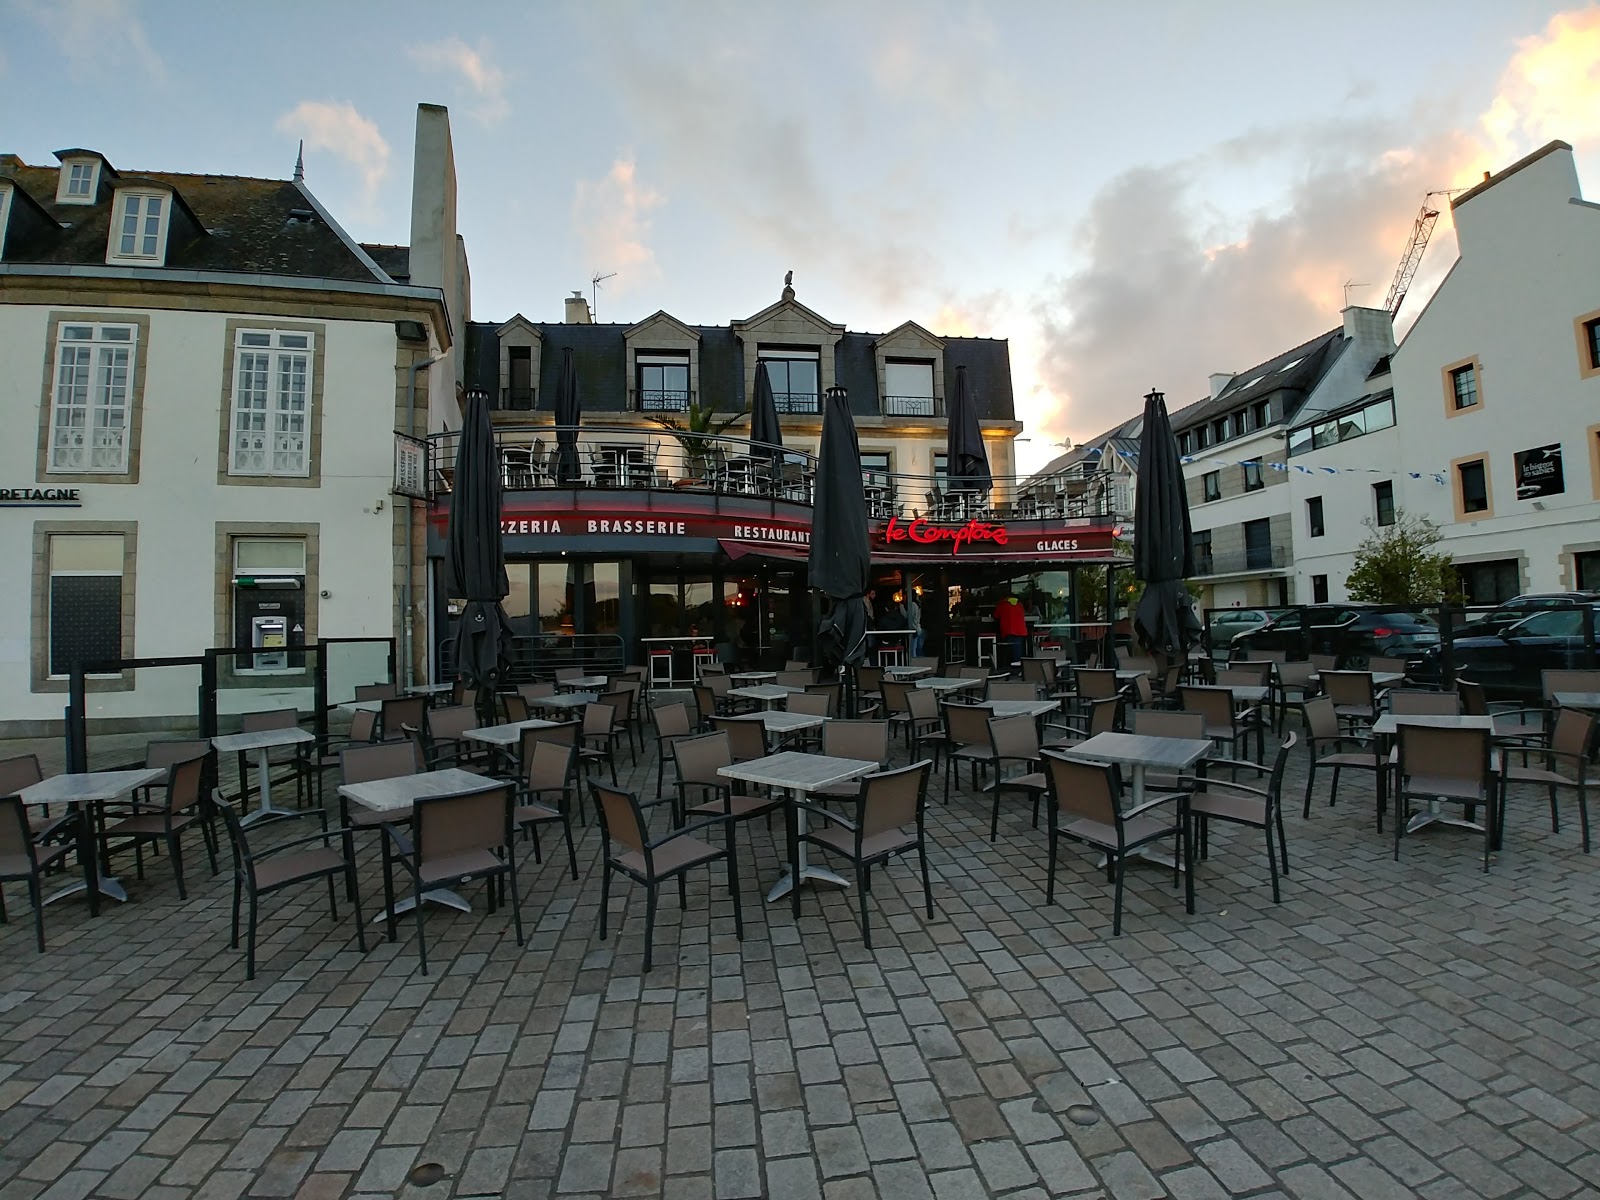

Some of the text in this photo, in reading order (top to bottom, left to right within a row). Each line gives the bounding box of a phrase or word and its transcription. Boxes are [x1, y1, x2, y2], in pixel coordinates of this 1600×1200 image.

[587, 519, 686, 535] BRASSERIE
[734, 525, 811, 543] RESTAURANT
[1036, 539, 1079, 551] GLACES
